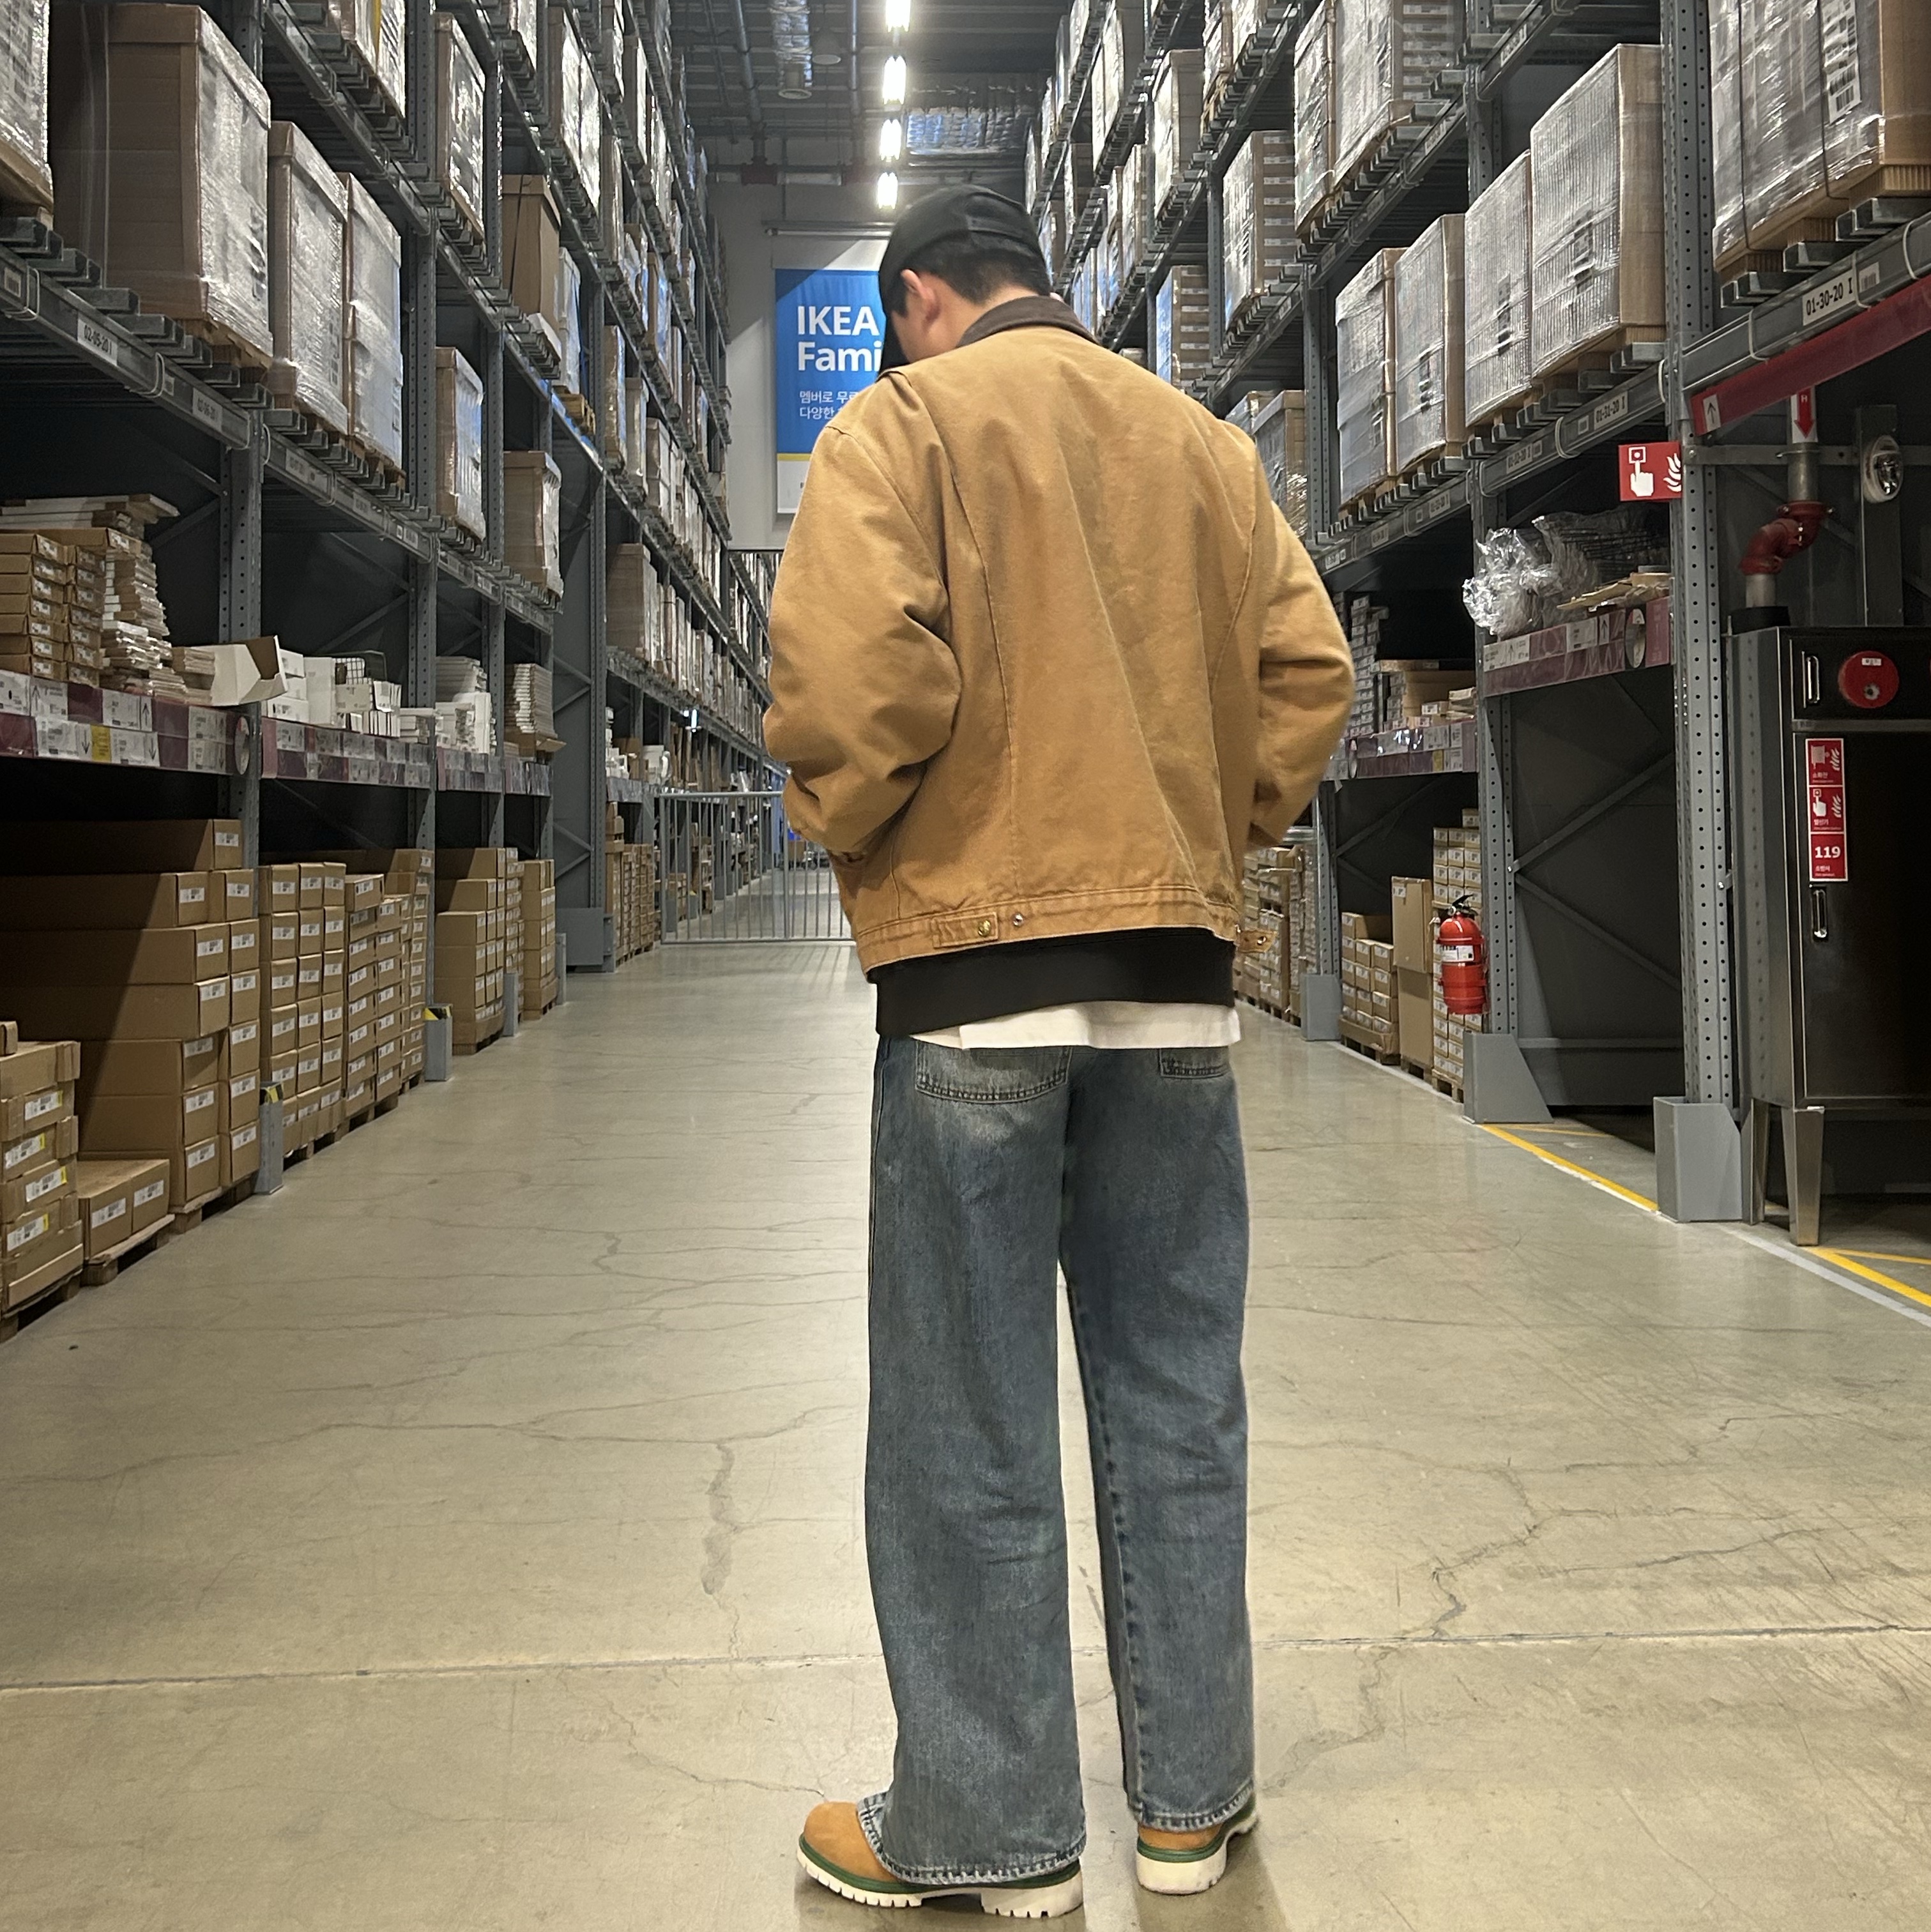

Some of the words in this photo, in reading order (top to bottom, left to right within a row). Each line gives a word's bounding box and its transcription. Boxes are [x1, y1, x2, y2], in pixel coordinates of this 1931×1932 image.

[1806, 282, 1843, 316] 01-30-20
[798, 306, 880, 336] IKEA
[798, 340, 883, 372] Fami
[800, 390, 834, 404] 멤버로
[800, 406, 834, 420] 다양한
[1815, 846, 1841, 858] 119
